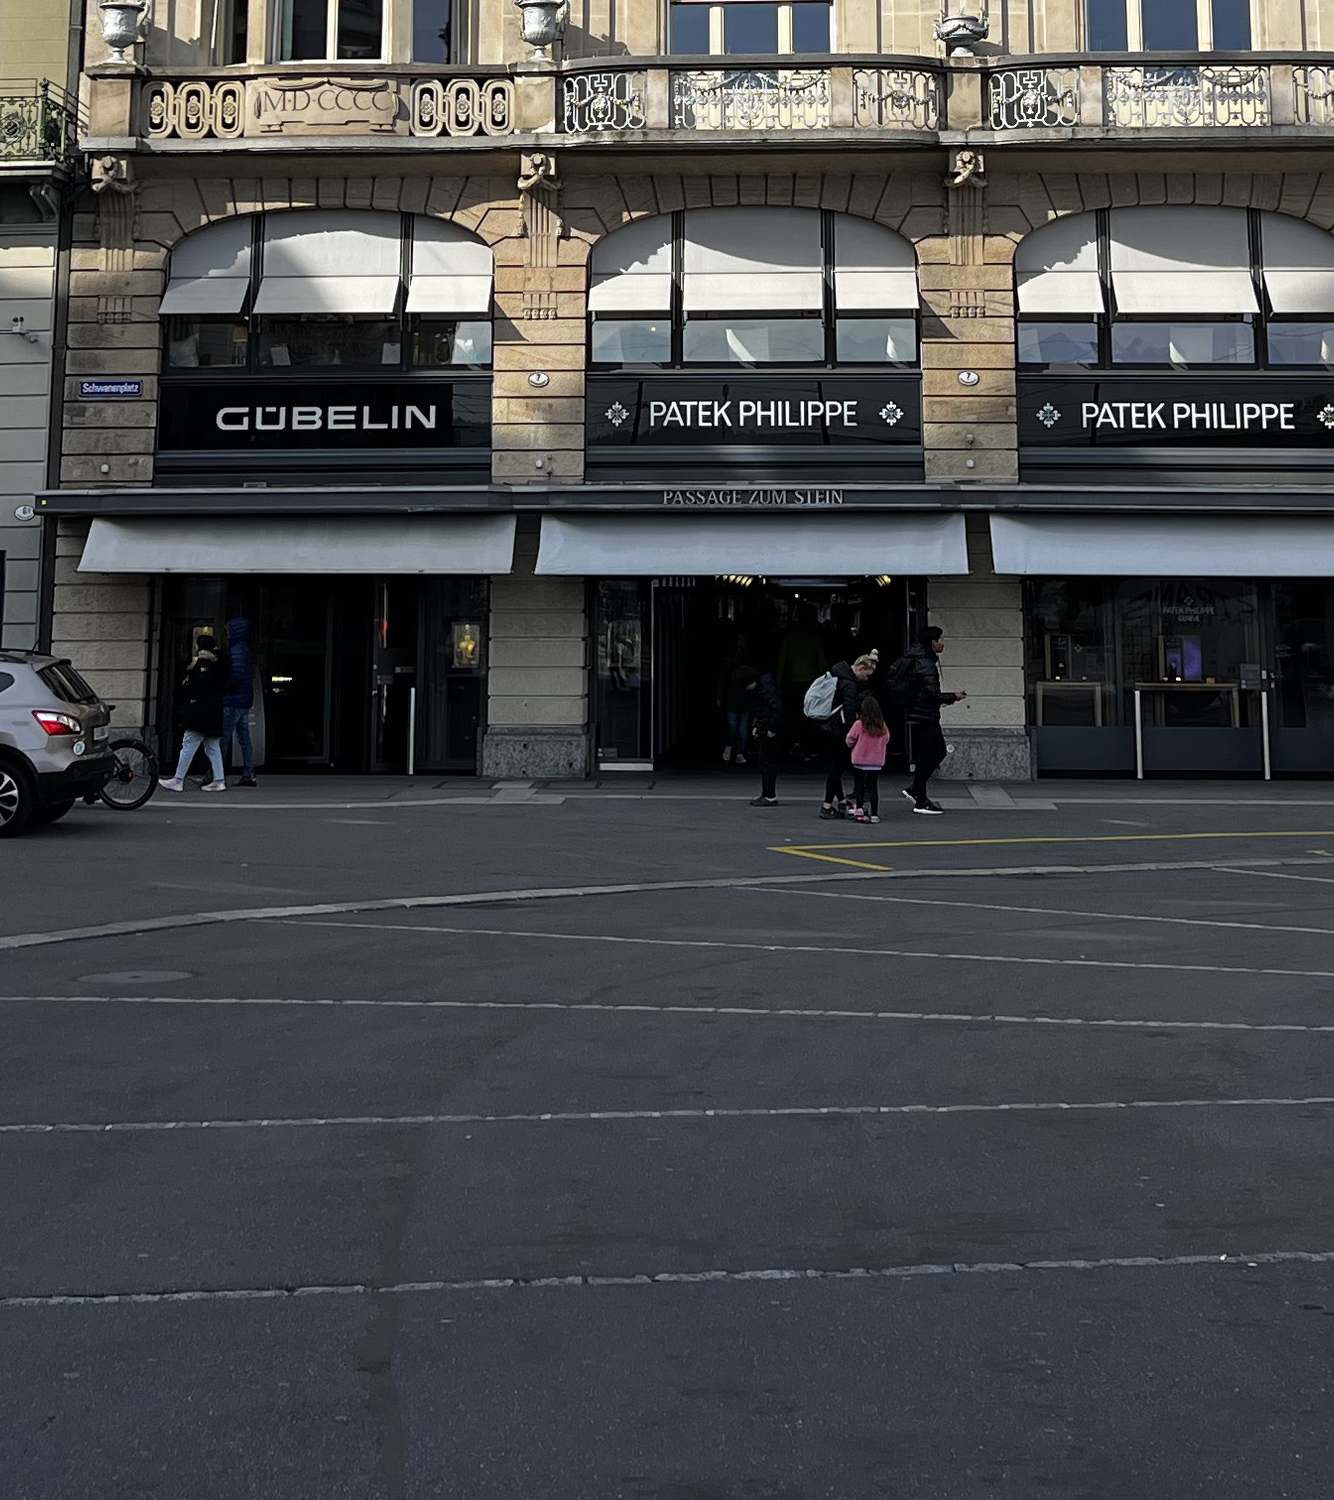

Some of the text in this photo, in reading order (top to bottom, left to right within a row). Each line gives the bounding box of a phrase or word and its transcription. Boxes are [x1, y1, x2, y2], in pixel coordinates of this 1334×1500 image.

[82, 382, 139, 394] Schwanenplatz
[216, 405, 436, 430] GÜBELIN
[649, 401, 858, 427] PATEK PHILIPPE
[1081, 402, 1296, 429] PATEK PHILIPPE
[663, 490, 843, 504] PASSAGE ZUM STEIN
